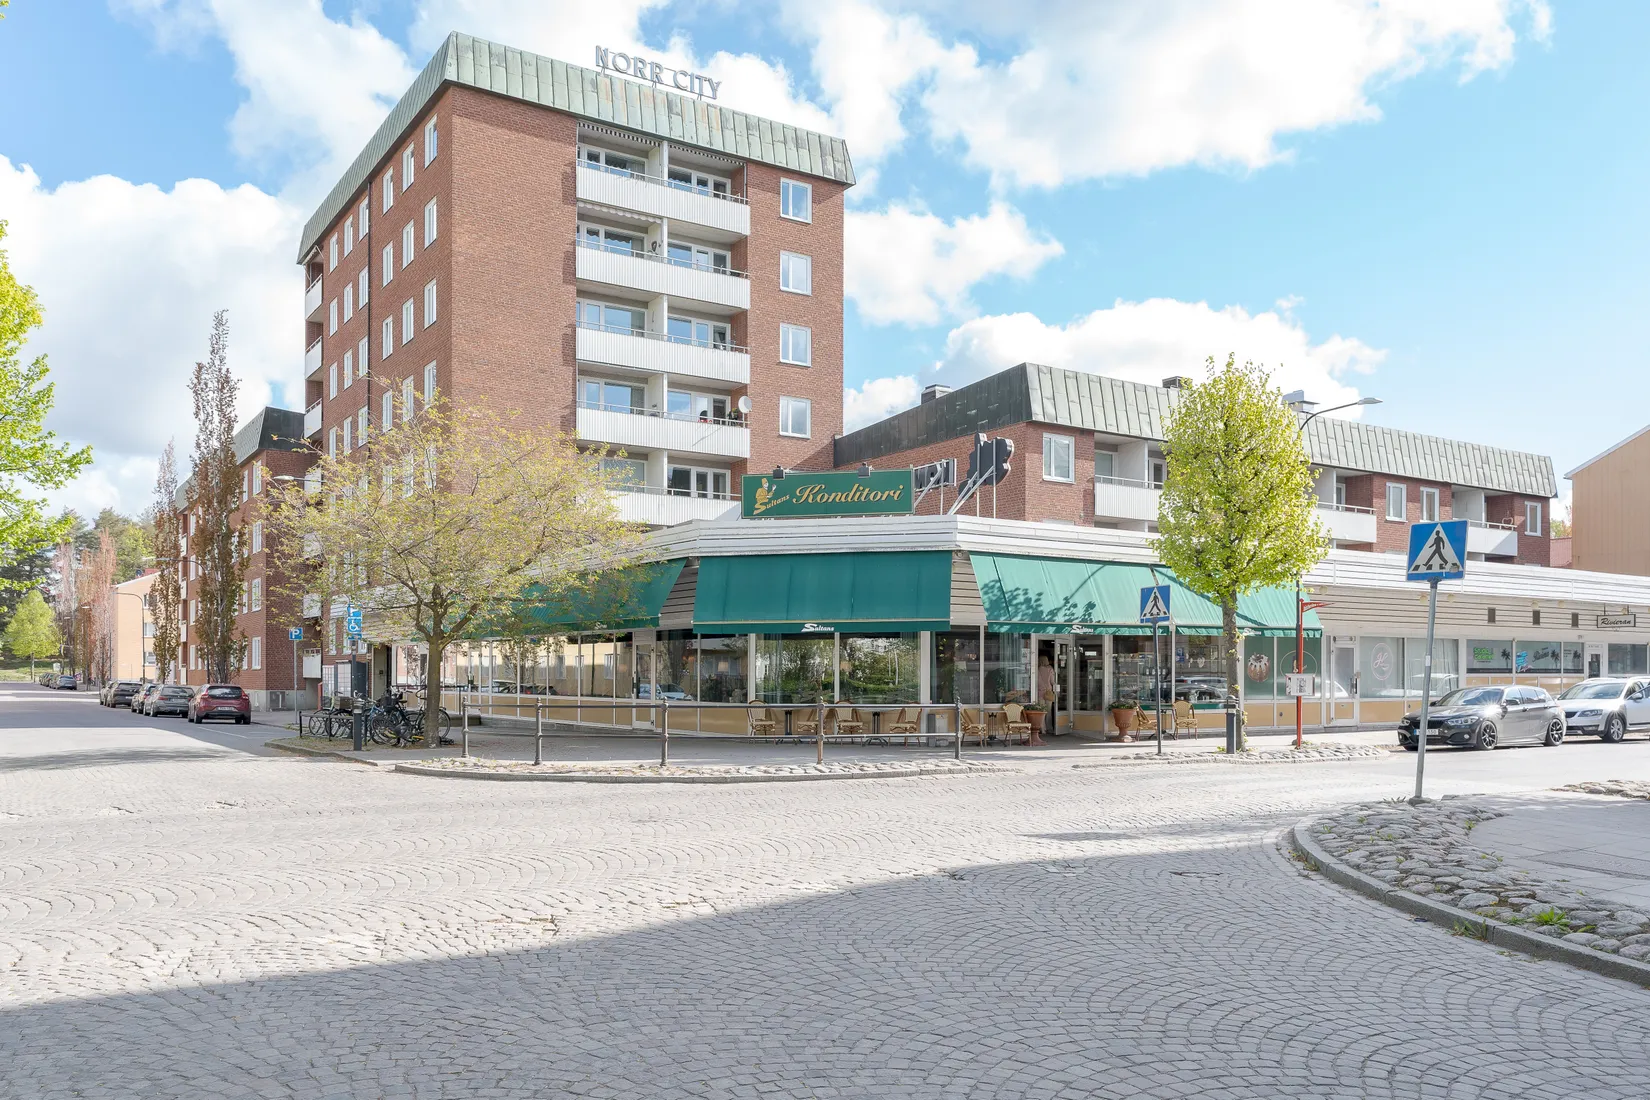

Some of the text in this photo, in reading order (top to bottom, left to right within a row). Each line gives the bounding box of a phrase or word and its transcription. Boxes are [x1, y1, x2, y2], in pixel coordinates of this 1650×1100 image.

[596, 45, 721, 99] NORR CITY
[753, 483, 905, 515] Sultans Konditori
[1600, 617, 1632, 625] Rivieran
